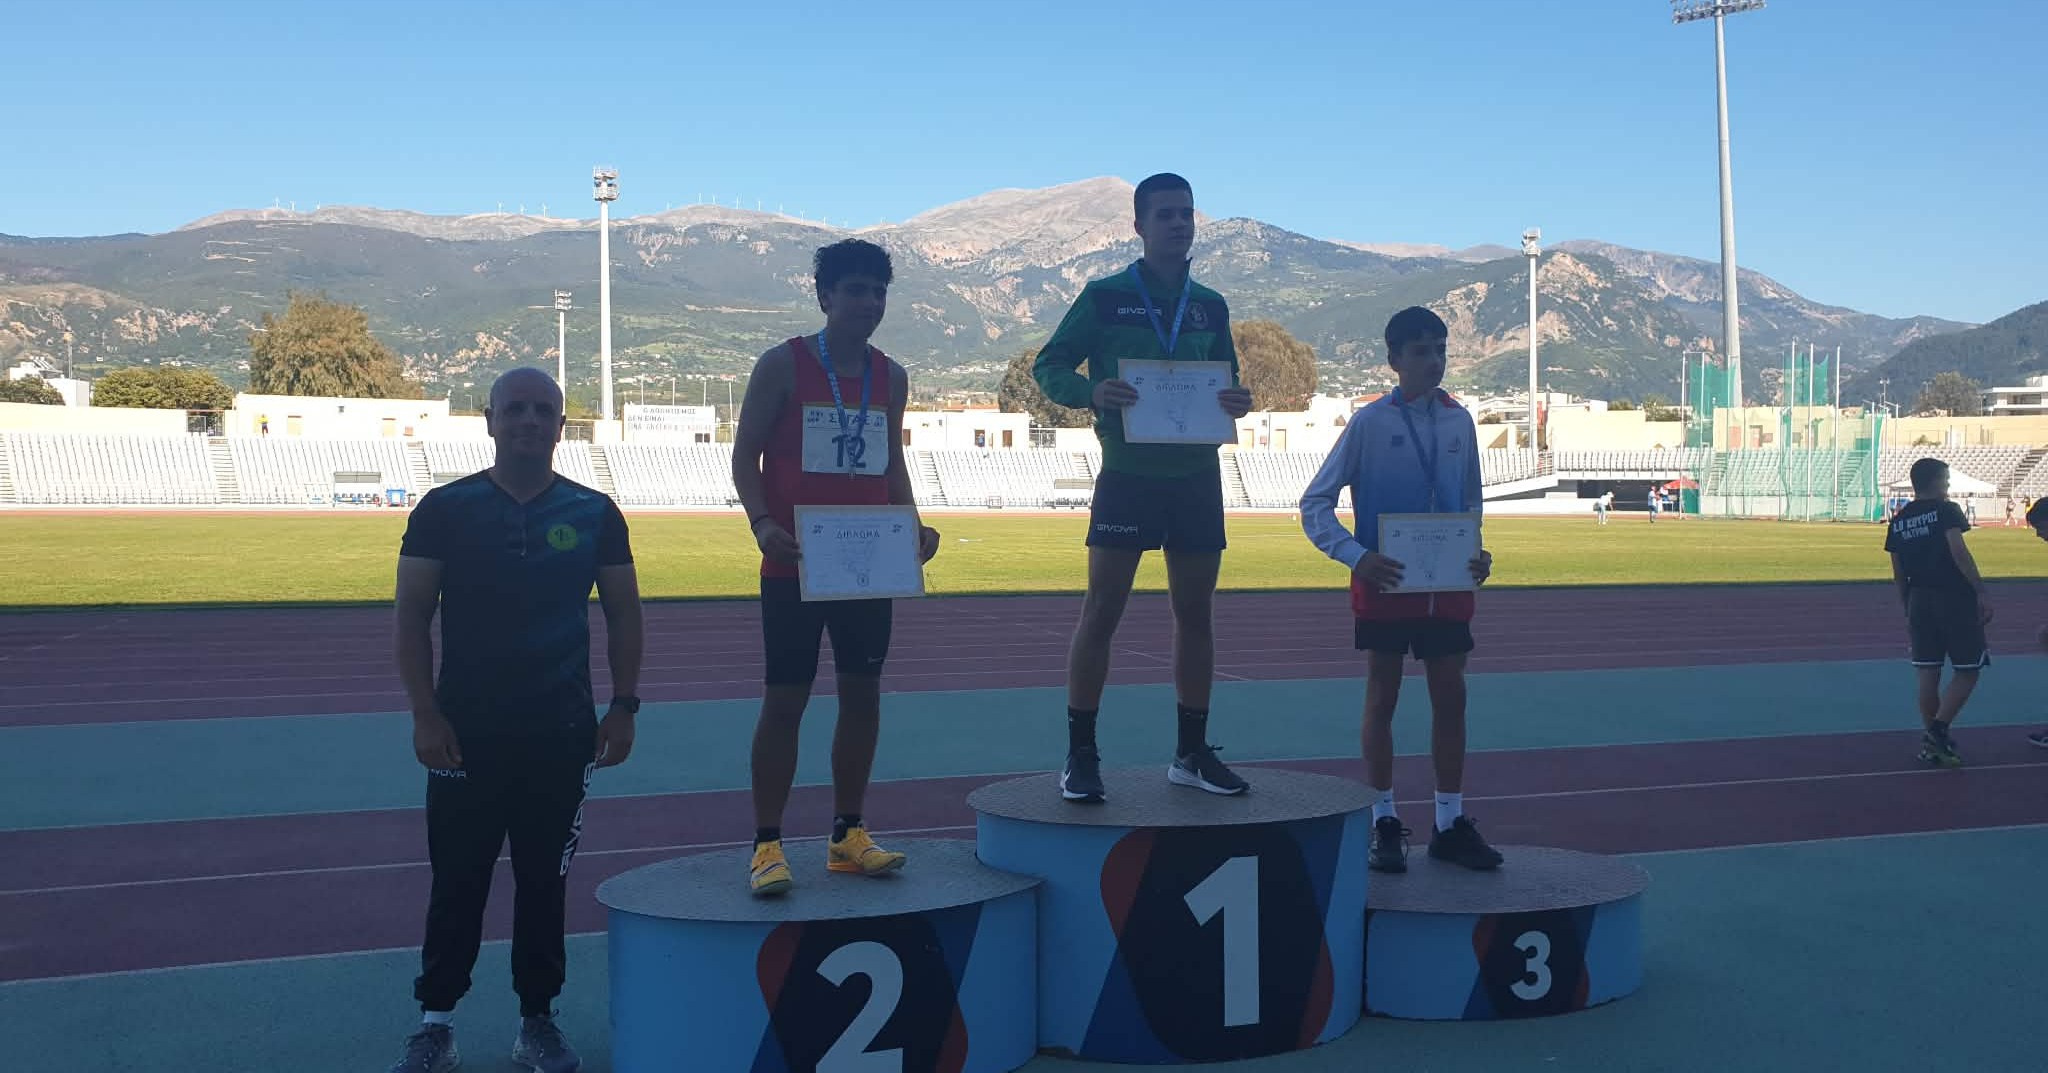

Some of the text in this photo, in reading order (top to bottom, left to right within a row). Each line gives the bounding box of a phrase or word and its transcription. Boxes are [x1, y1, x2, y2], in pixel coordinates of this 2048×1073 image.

[1118, 305, 1162, 316] GIVOA
[831, 434, 867, 468] 12
[1184, 856, 1260, 1027] 1
[1509, 930, 1552, 1000] 3
[814, 941, 903, 1073] 2
